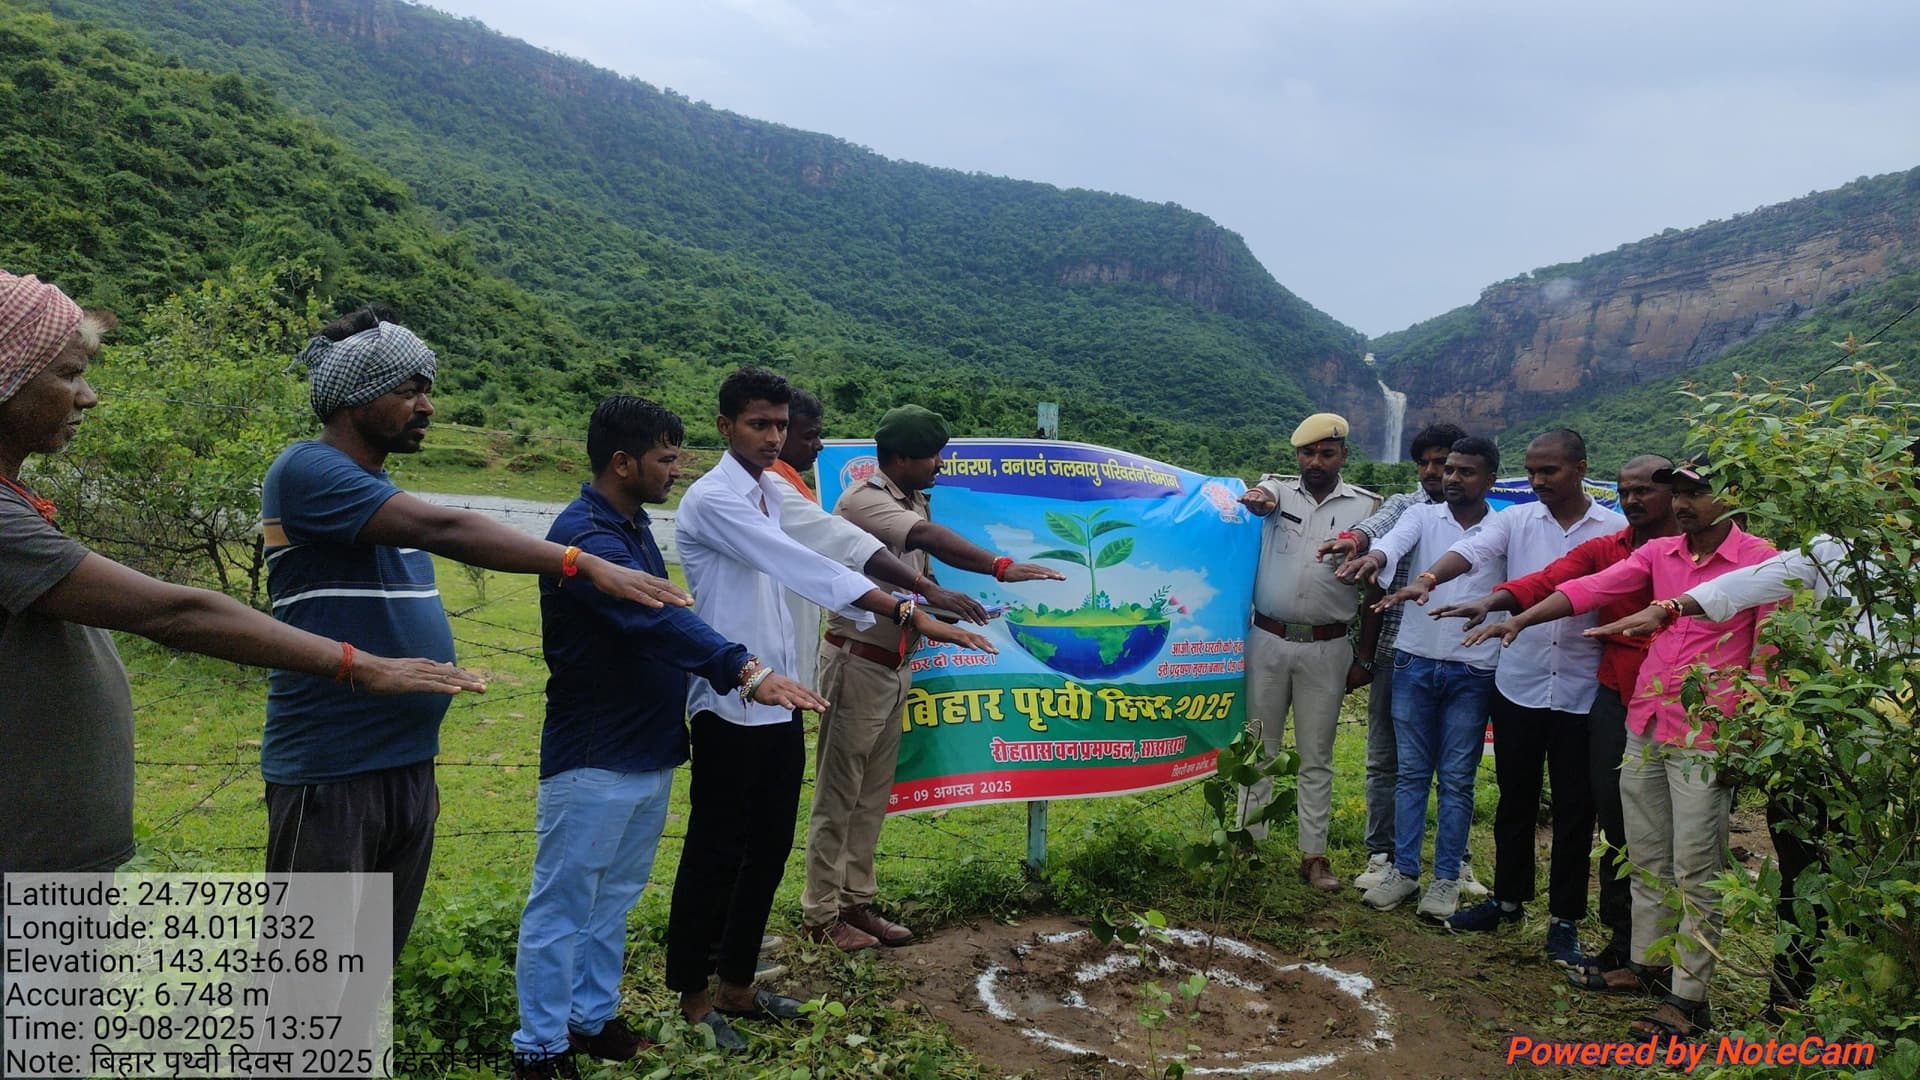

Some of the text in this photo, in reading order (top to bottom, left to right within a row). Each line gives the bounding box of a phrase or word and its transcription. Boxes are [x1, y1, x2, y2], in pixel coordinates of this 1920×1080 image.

[937, 452, 997, 477] र्यावरण,
[1048, 460, 1102, 487] जलवायु
[933, 653, 949, 669] दो
[902, 688, 1004, 732] बिहार
[1012, 681, 1093, 732] पृथ्वी
[991, 737, 1052, 761] रोहतास
[1054, 741, 1078, 760] वन
[913, 789, 929, 802] 09
[934, 783, 974, 799] अगस्त
[980, 781, 1012, 794] 2025
